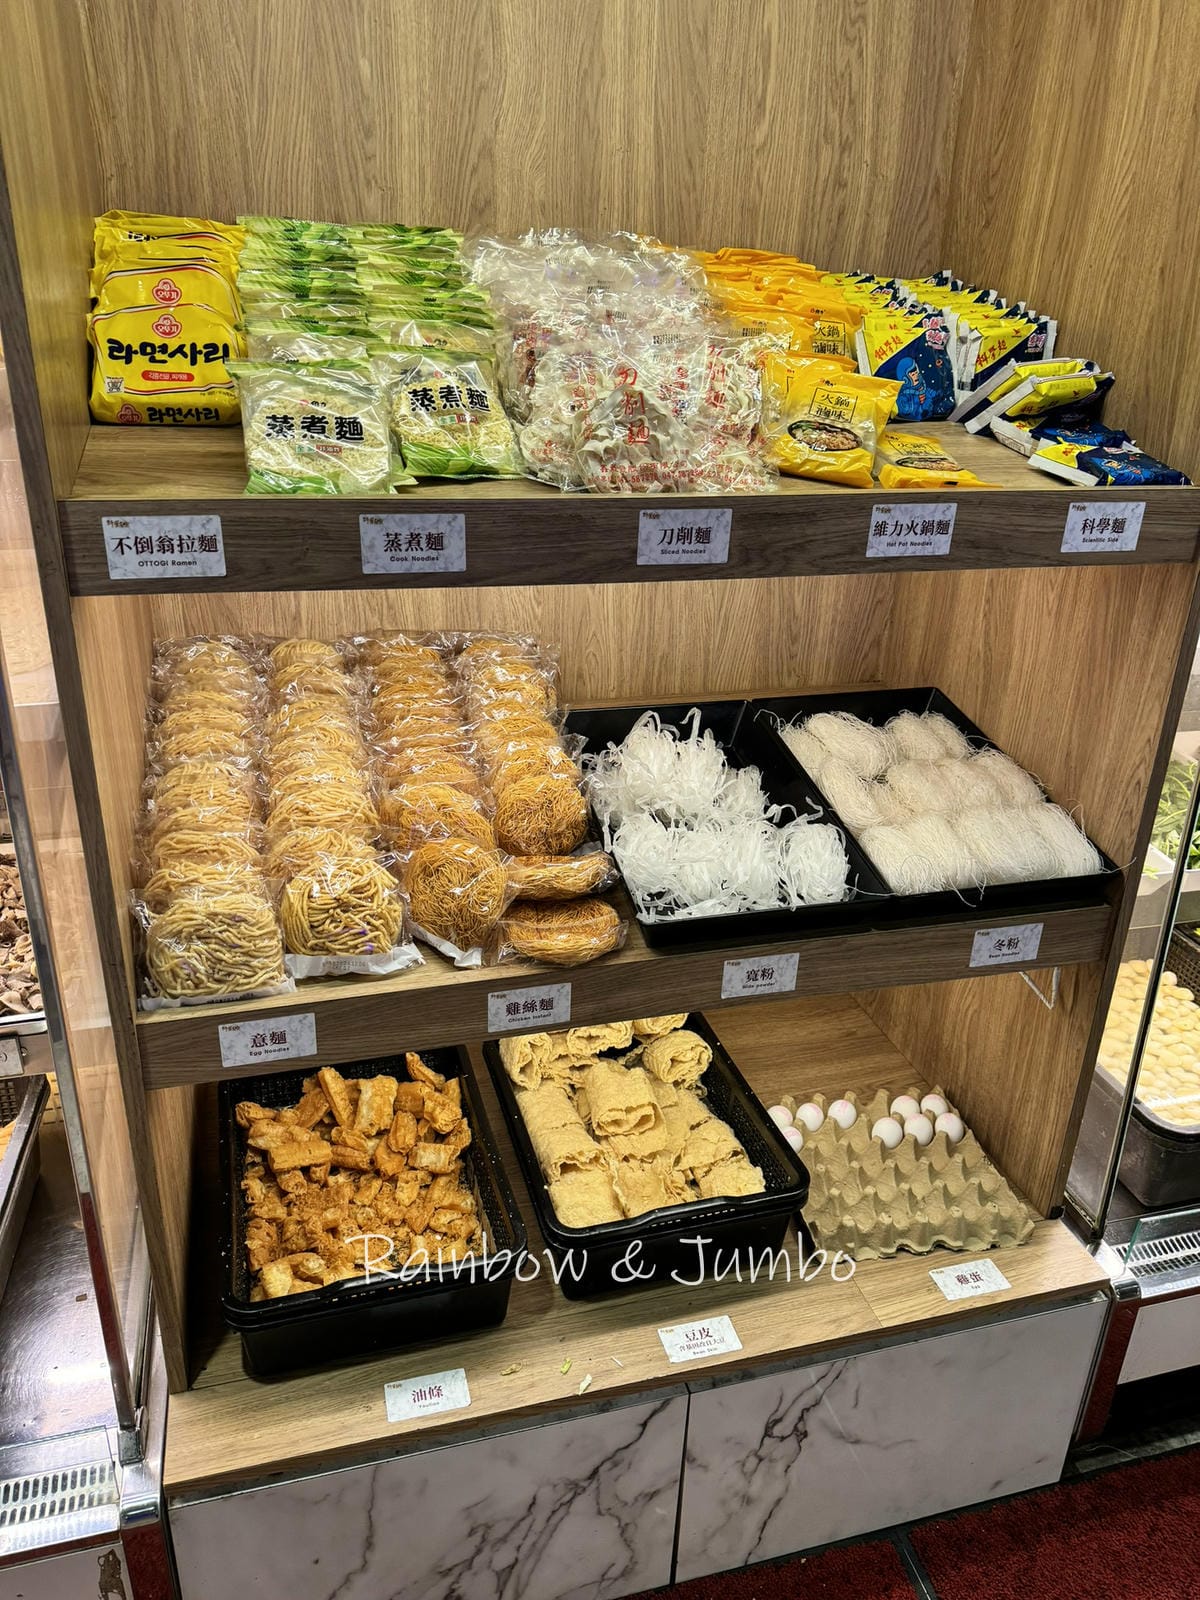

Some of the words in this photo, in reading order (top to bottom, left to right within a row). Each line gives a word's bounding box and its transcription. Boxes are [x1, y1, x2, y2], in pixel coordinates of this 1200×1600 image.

[815, 324, 840, 338] 火鍋
[107, 338, 229, 366] 라면사리
[408, 385, 491, 412] 蒸煮麵
[821, 393, 850, 407] 火鍋
[146, 407, 220, 424] 라면사리
[265, 414, 365, 441] 蒸煮麵
[872, 519, 952, 537] 維力火鍋麵
[1080, 517, 1127, 535] 科學麵
[111, 534, 219, 556] 不倒翁拉麵
[382, 531, 446, 553] 蒸煮麵
[657, 526, 713, 546] 刀削麵
[993, 937, 1020, 952] 冬粉
[745, 967, 775, 983] 寬粉
[505, 997, 554, 1017] 雞絲麵
[249, 1030, 288, 1049] 意麵
[685, 1327, 713, 1342] 豆皮
[412, 1385, 444, 1404] 油條
